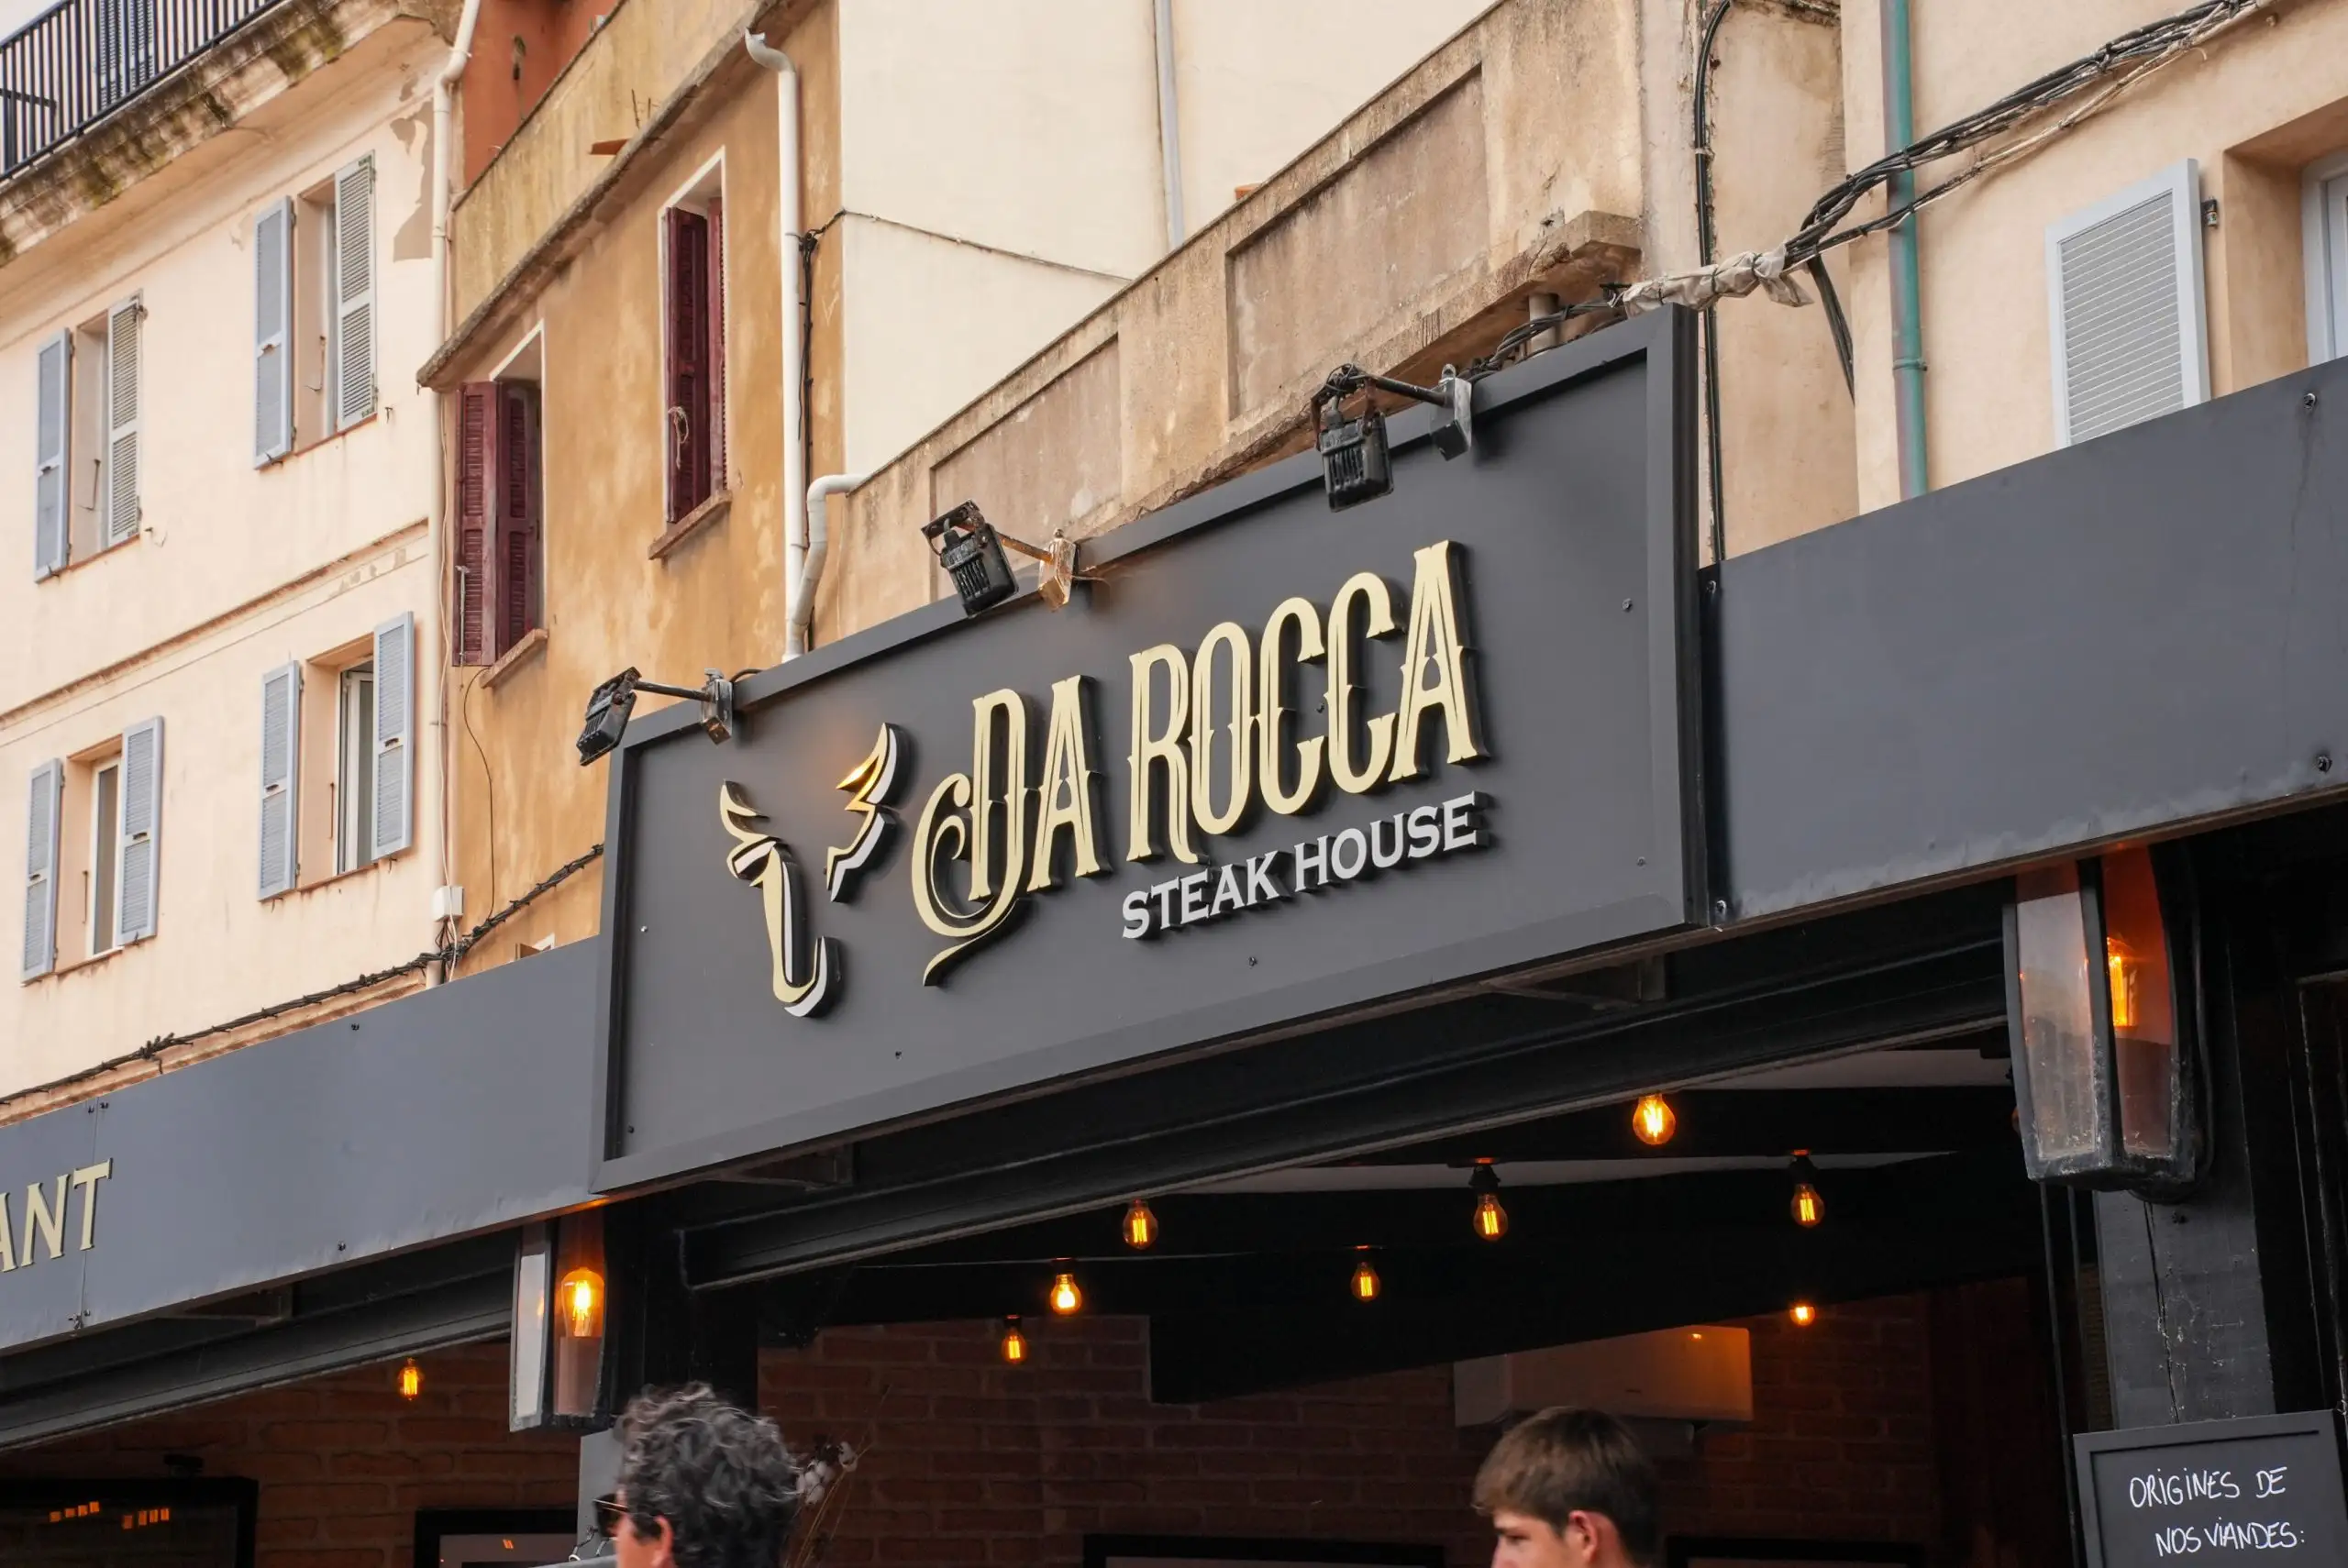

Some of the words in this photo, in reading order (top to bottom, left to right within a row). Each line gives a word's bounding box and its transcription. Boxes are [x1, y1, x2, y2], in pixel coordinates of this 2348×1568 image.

[912, 675, 1103, 988] DA
[1126, 539, 1484, 866] ROCCA
[1122, 850, 1280, 940] STEAK
[1294, 790, 1479, 893] HOUSE
[2255, 1466, 2287, 1499] DE
[2155, 1527, 2202, 1557] NOS
